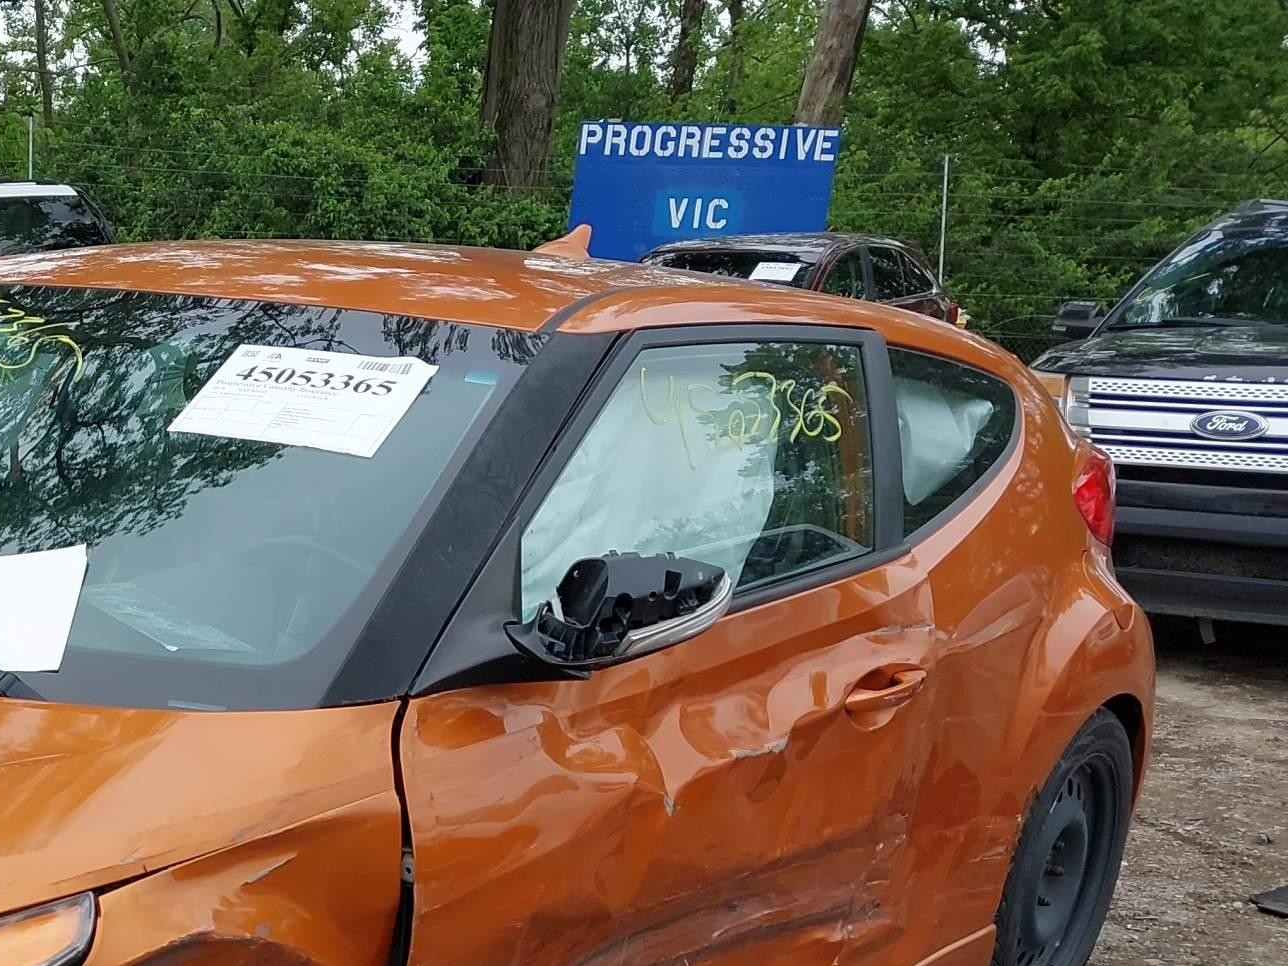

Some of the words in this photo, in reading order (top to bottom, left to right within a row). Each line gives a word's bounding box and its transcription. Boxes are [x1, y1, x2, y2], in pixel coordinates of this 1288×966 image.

[579, 123, 839, 162] PROGRESSIVE
[669, 197, 729, 230] VIC
[235, 365, 399, 397] 45053365
[1206, 414, 1247, 433] Ford
